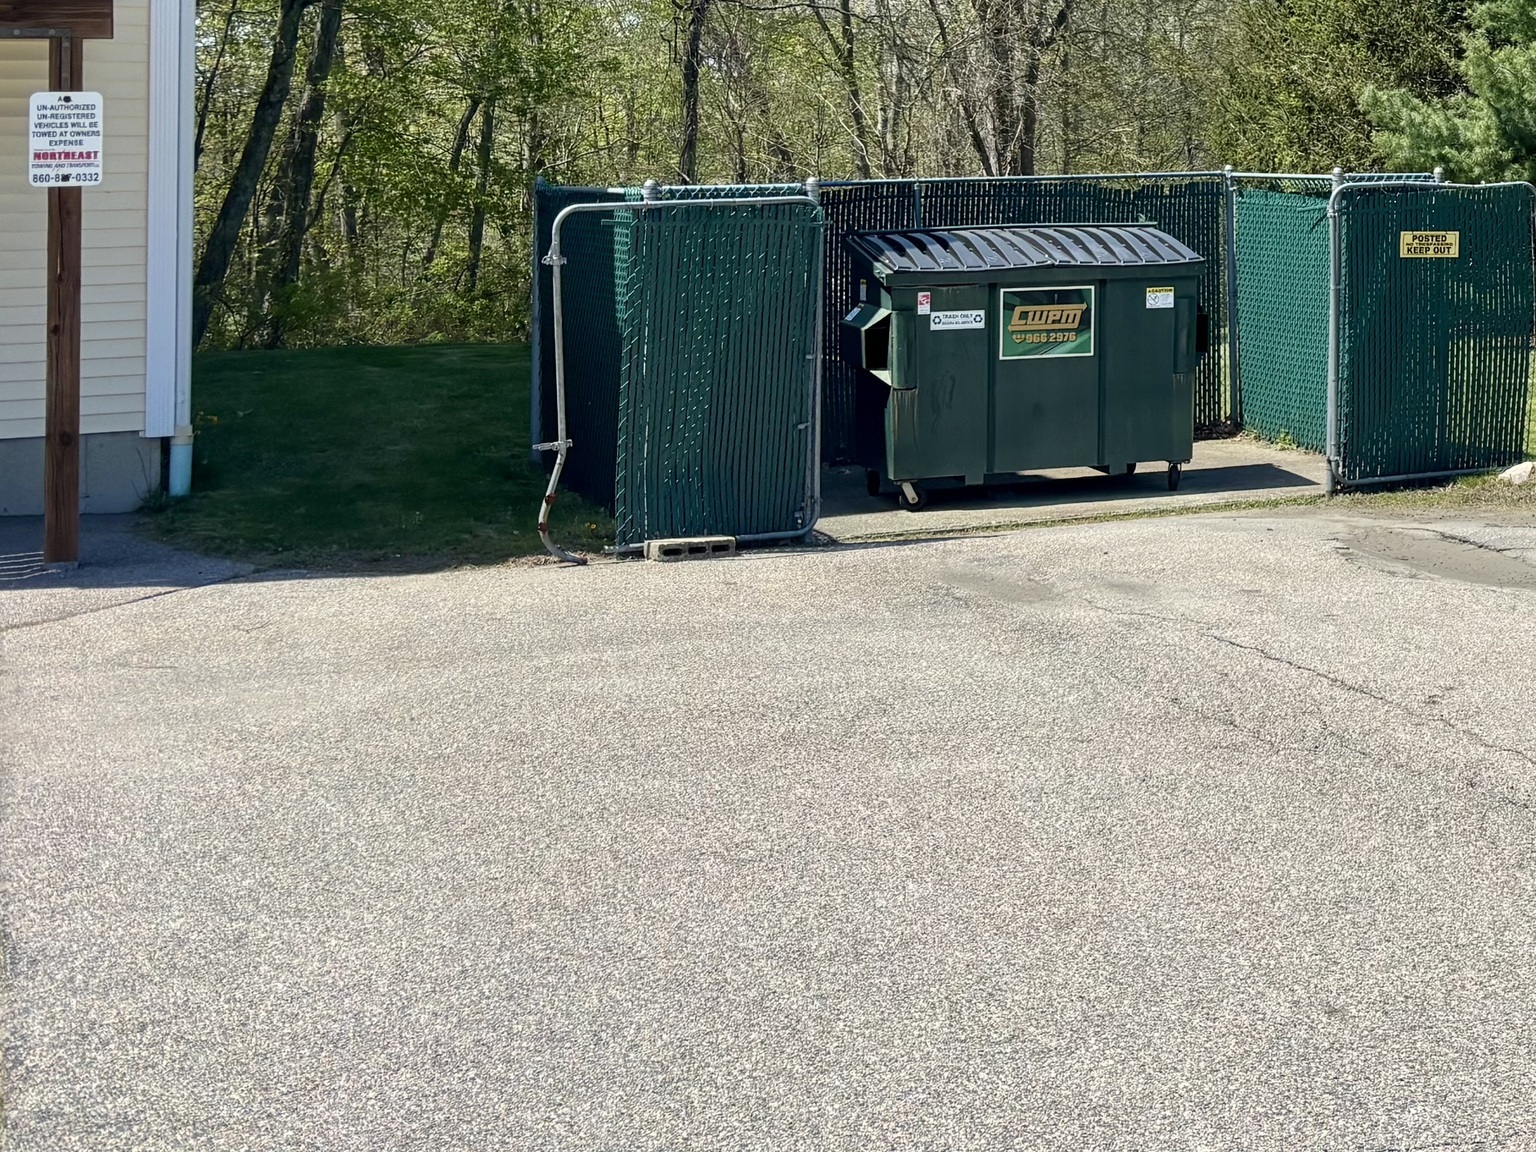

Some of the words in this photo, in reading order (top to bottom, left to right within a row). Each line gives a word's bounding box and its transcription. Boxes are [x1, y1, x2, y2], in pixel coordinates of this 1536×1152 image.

[33, 151, 99, 161] NORTHEAST
[32, 173, 99, 183] 860-87-0332
[1412, 234, 1447, 242] POSTED
[1407, 246, 1431, 254] KEEP
[1433, 246, 1451, 254] OUT
[1008, 302, 1087, 332] CWPM
[1025, 333, 1048, 343] 966
[1049, 332, 1077, 342] 2976
